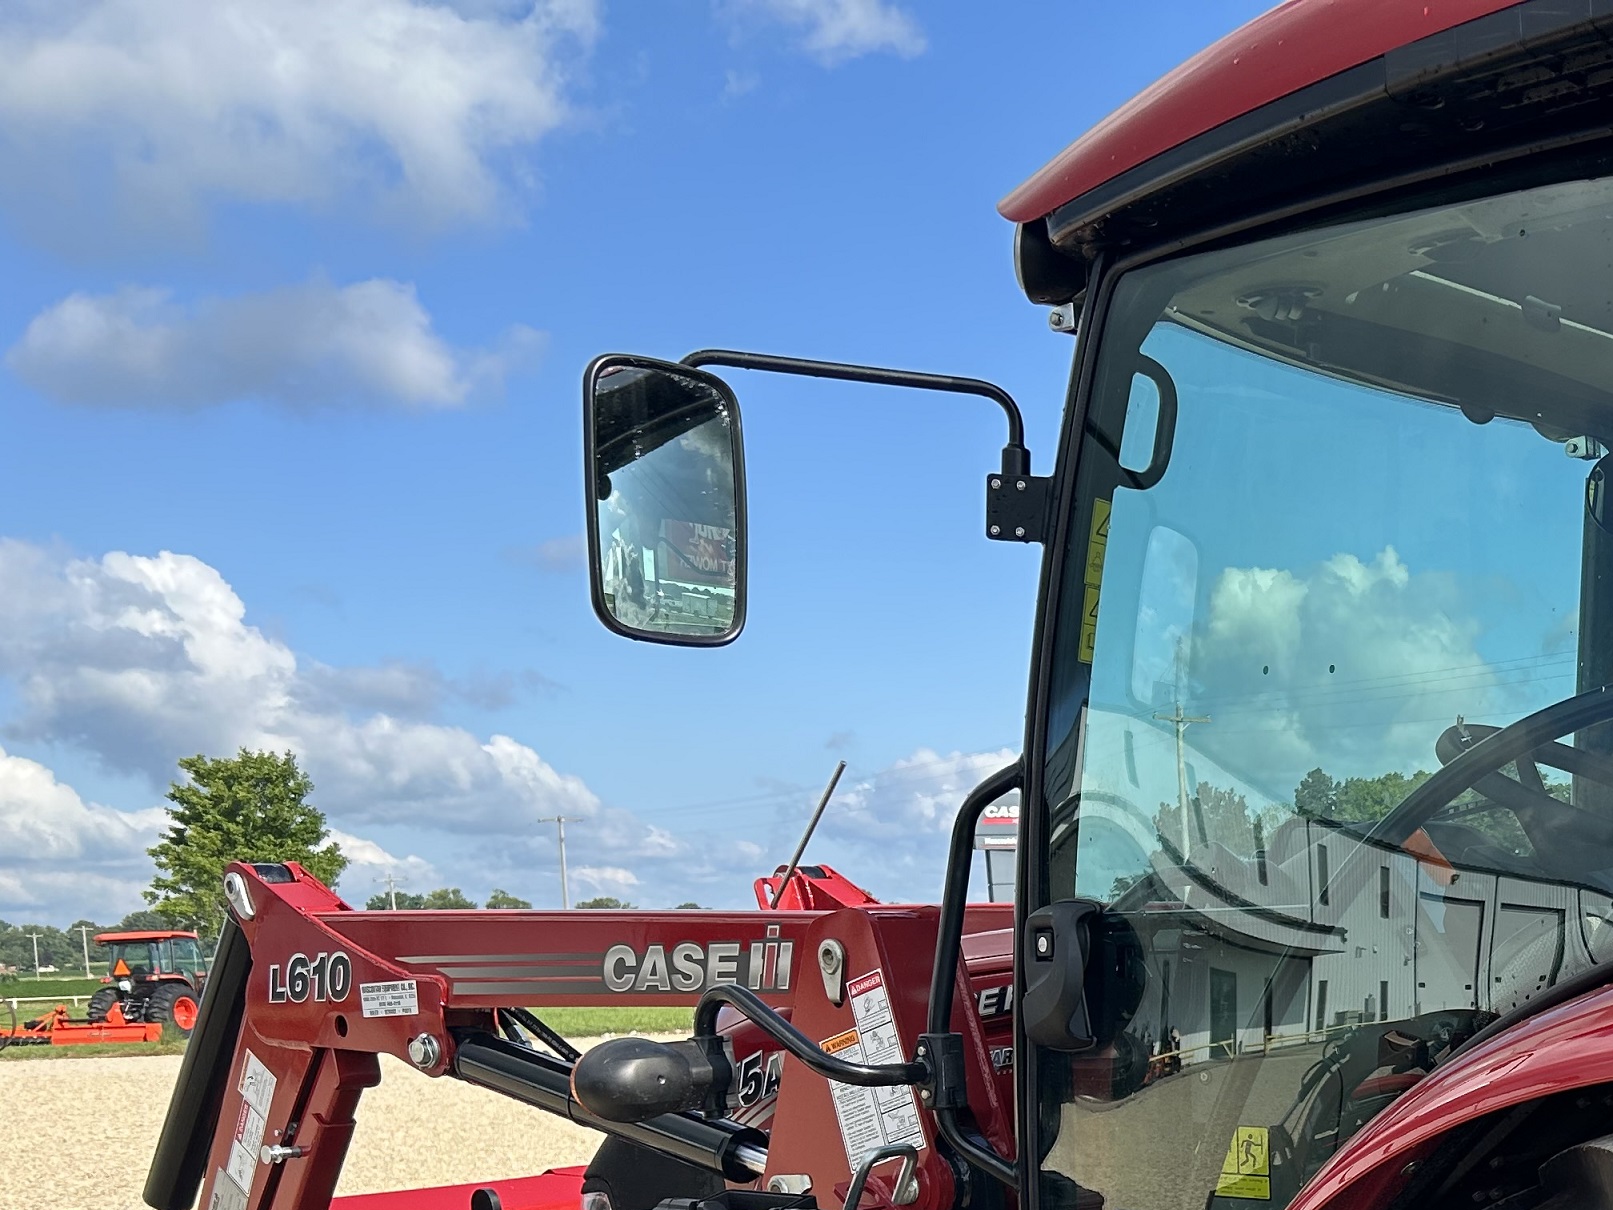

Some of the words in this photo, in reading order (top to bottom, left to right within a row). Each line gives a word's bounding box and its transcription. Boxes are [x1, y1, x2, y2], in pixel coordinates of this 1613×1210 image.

[984, 805, 1019, 818] CAS
[269, 951, 352, 1003] L610
[603, 943, 740, 992] CASE
[736, 1050, 783, 1107] 5A
